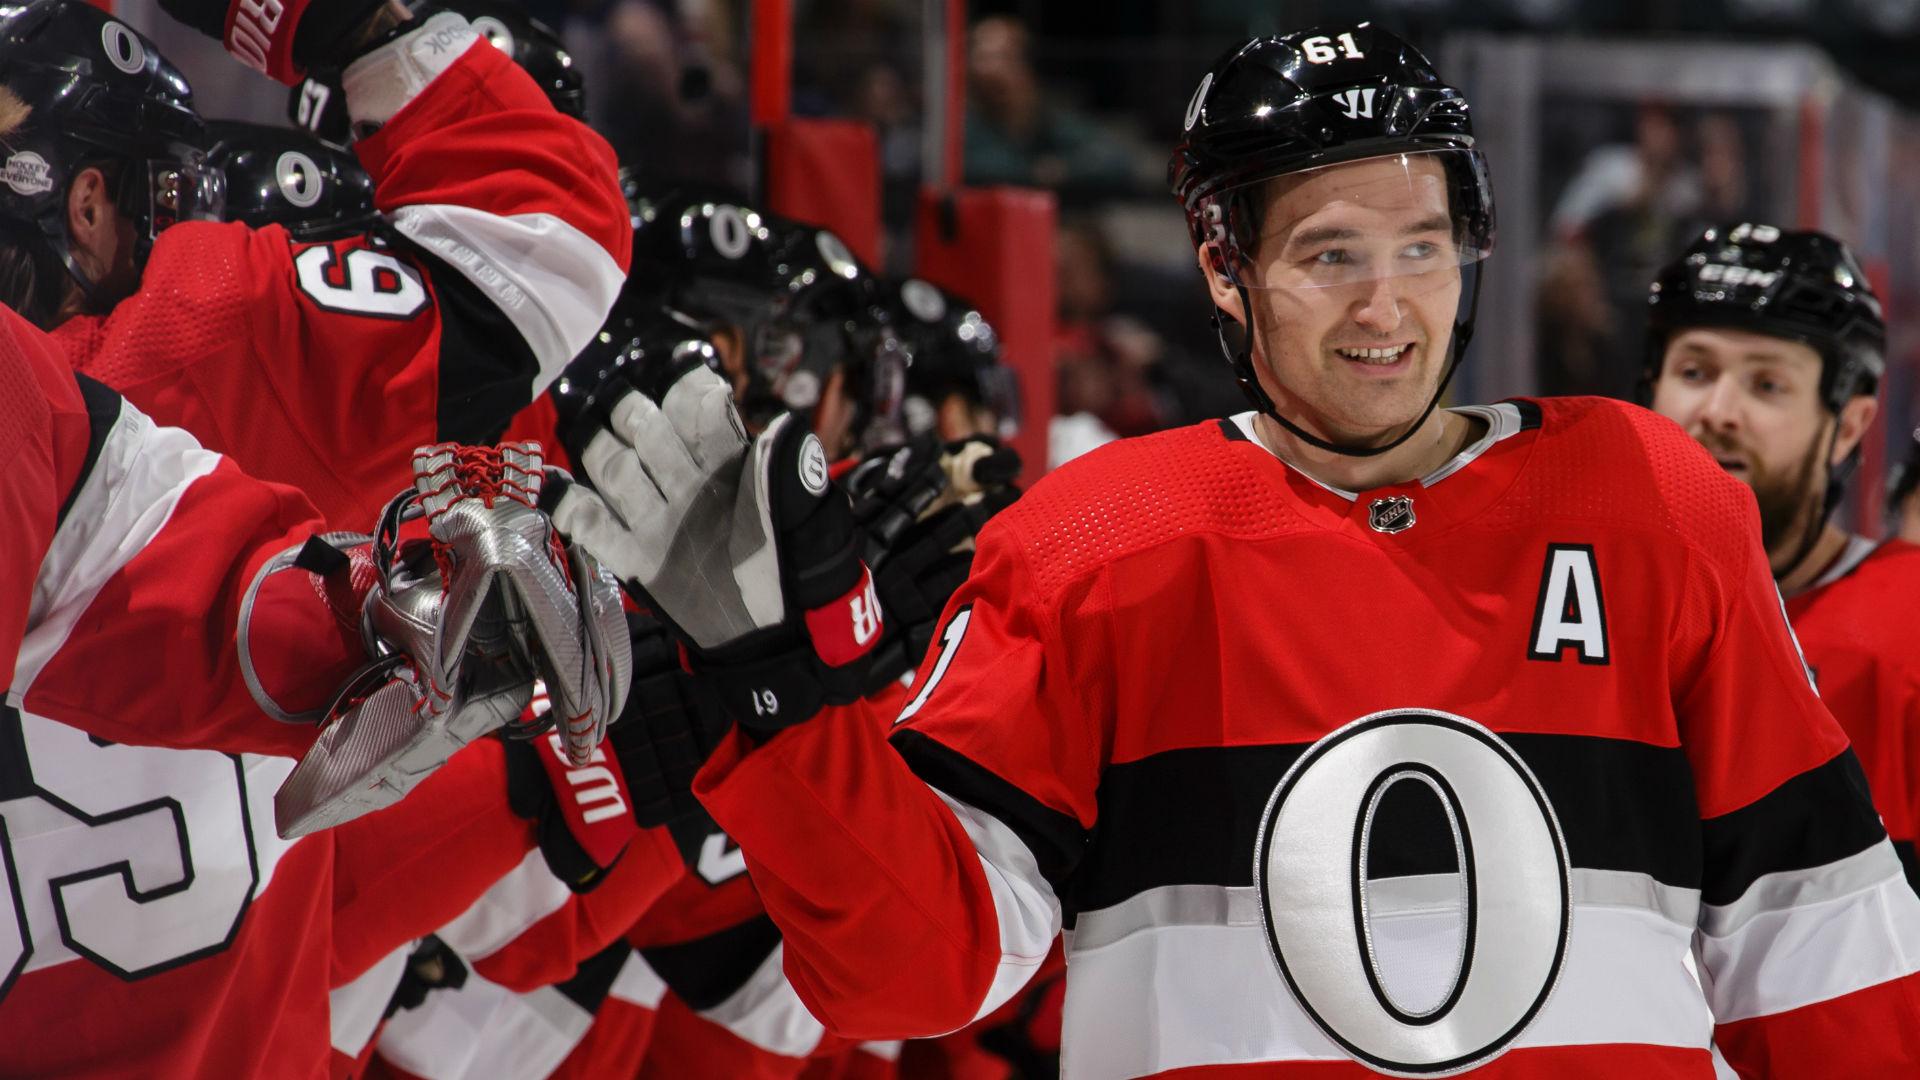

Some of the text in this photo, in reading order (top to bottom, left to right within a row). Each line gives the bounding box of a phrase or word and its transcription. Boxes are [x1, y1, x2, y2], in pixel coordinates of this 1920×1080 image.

[1301, 32, 1365, 64] 61
[8, 158, 48, 174] HOCKEY
[1379, 503, 1406, 527] NHL
[1527, 543, 1610, 666] A
